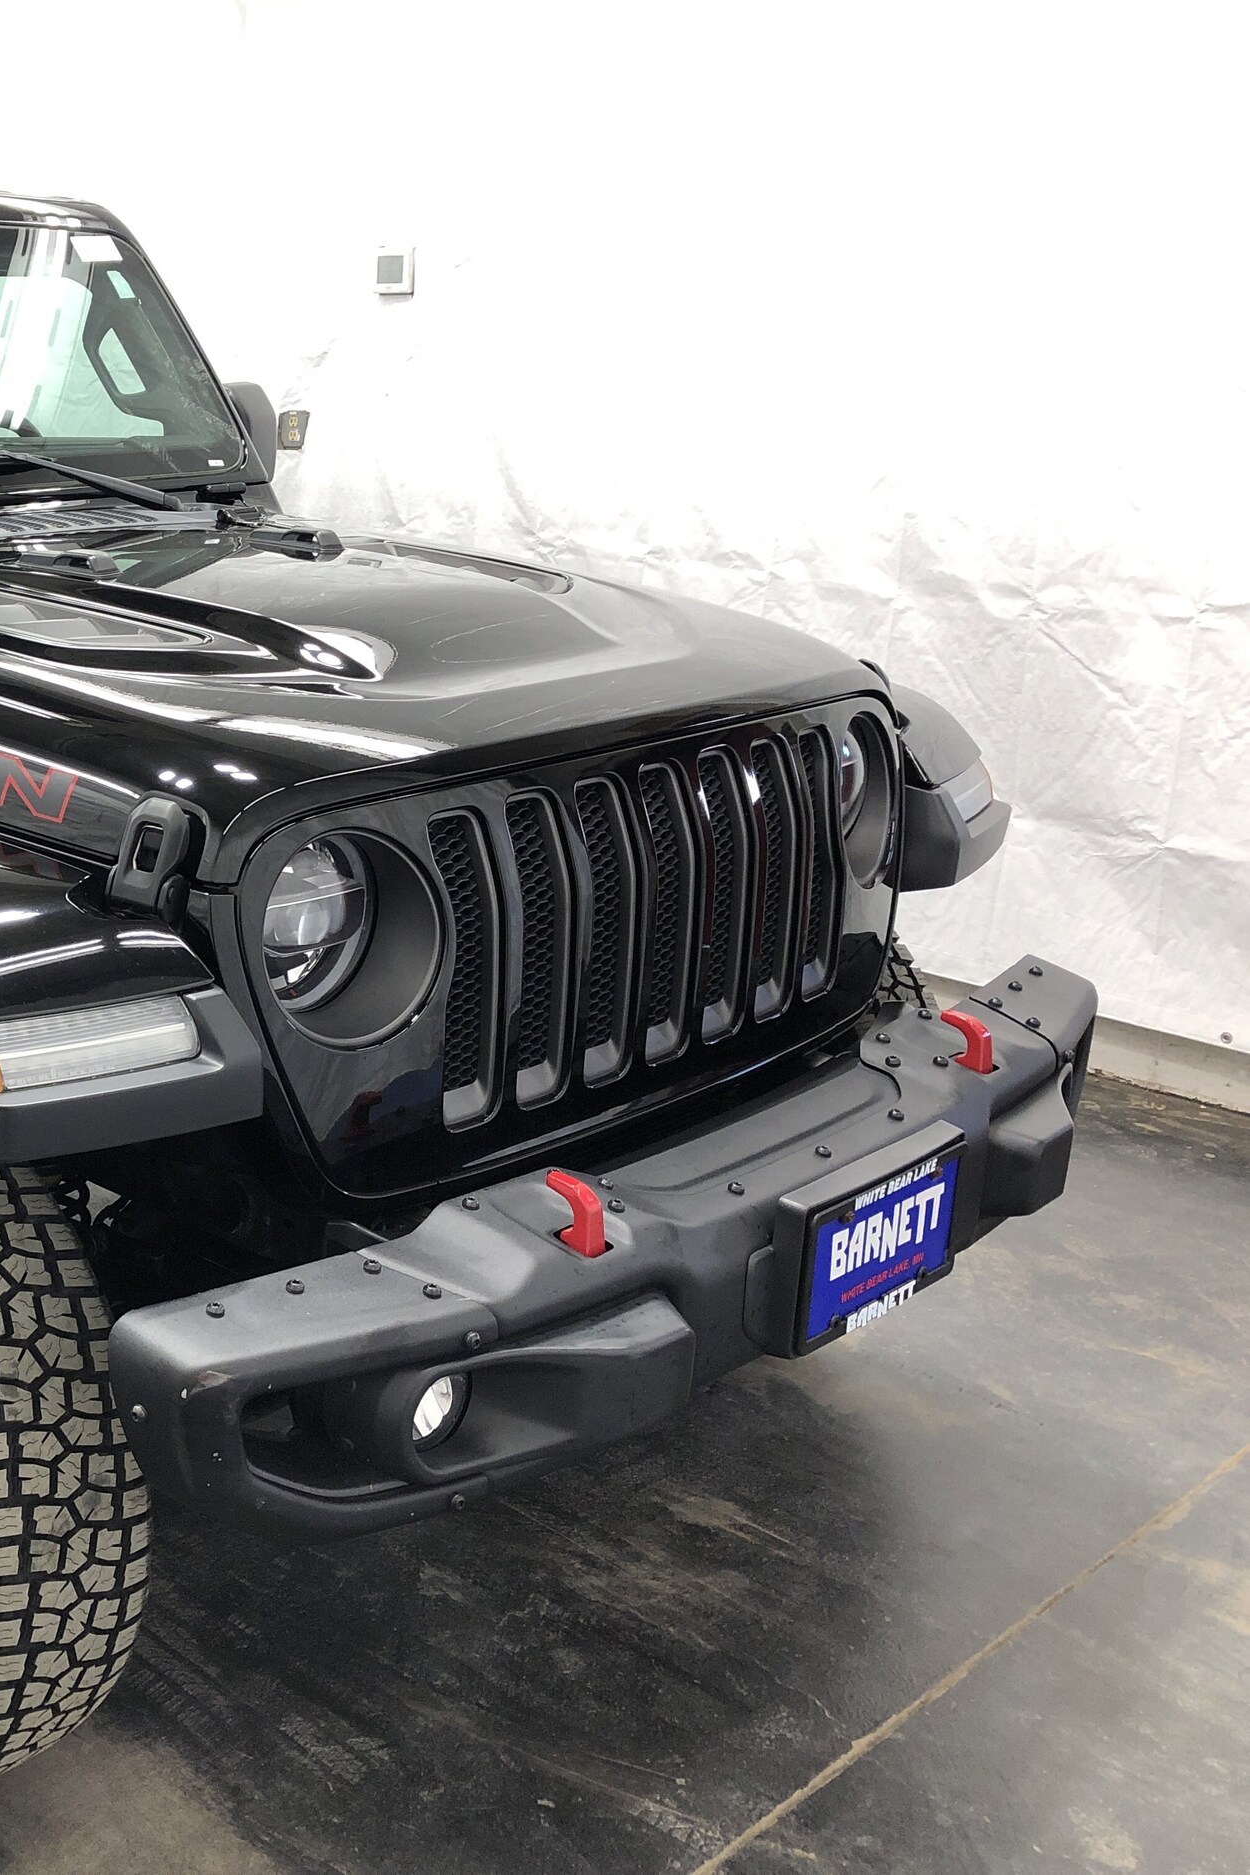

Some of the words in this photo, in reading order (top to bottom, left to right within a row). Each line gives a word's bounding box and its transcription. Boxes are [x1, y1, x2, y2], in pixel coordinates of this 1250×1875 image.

[854, 1186, 886, 1211] WHITE
[887, 1171, 912, 1195] BEAR
[914, 1158, 938, 1182] LAKE
[829, 1182, 946, 1281] BARNETT
[846, 1279, 918, 1334] BARNETT
